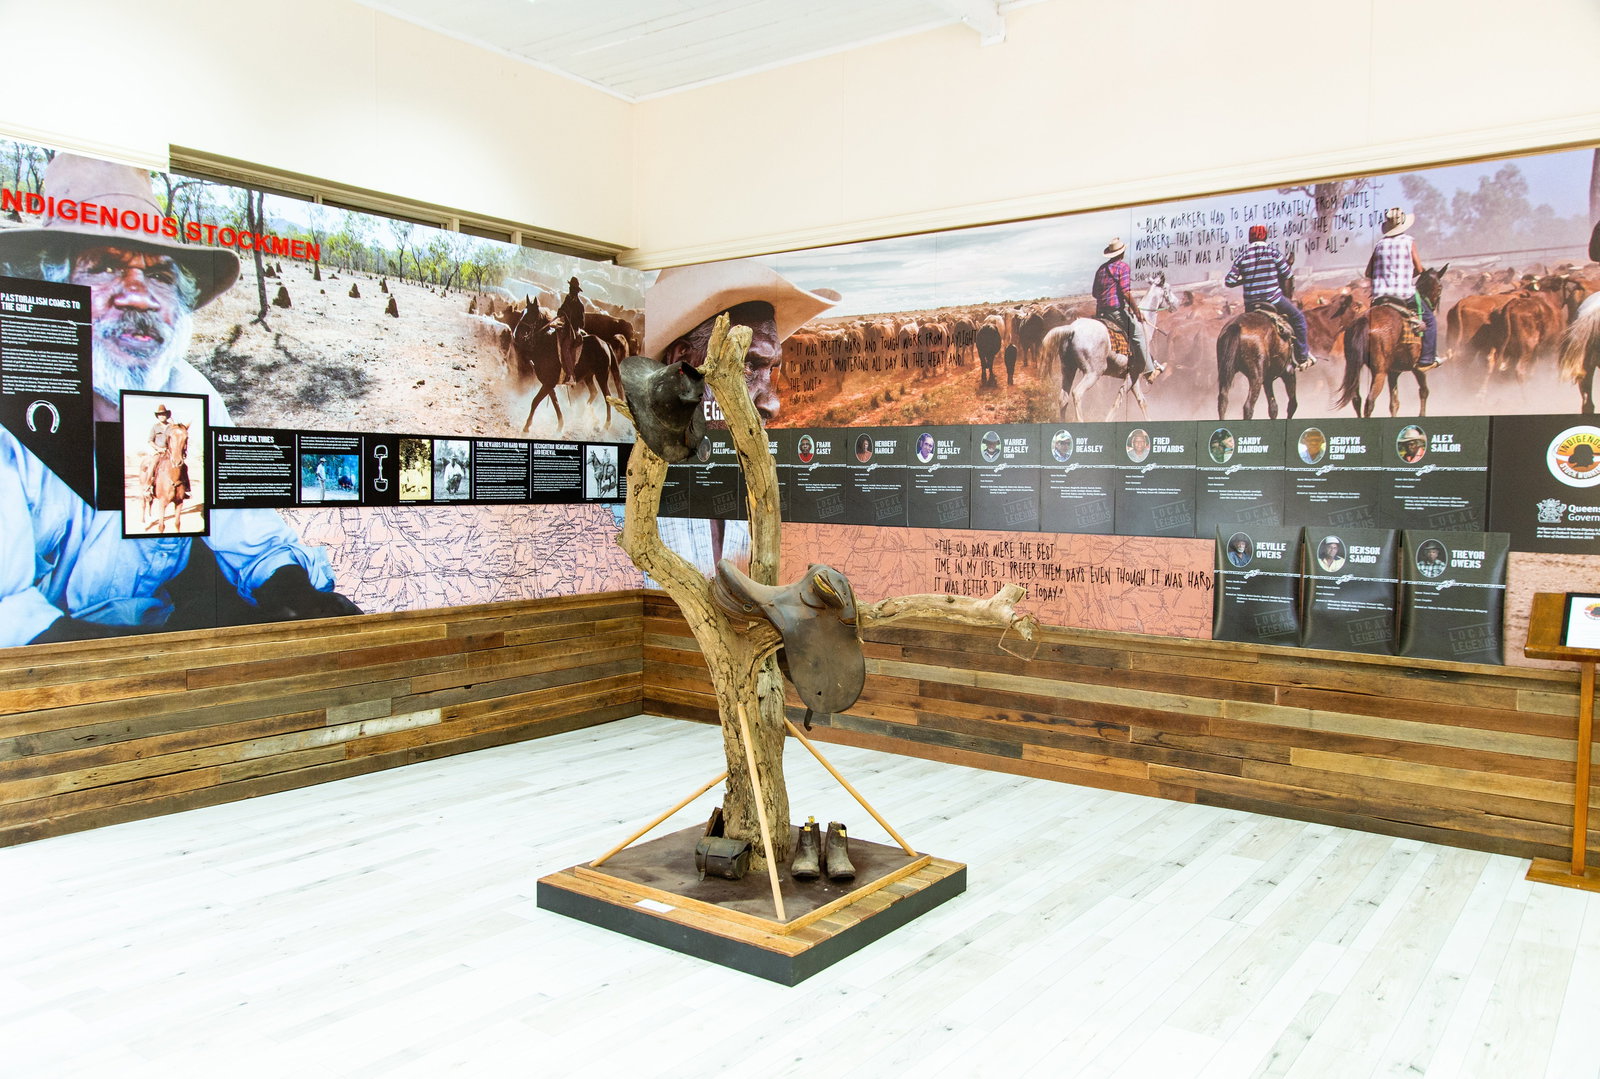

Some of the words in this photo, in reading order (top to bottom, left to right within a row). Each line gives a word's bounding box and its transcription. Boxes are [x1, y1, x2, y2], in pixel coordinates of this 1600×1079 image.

[1171, 211, 1206, 228] WORKERS
[1210, 209, 1225, 225] HAD
[1231, 207, 1239, 220] TO
[1244, 205, 1258, 222] EAT
[1263, 200, 1311, 219] SEPARATELY
[1316, 195, 1338, 211] FROM
[1342, 191, 1370, 209] WHITE
[1198, 227, 1230, 246] STARTED
[1235, 226, 1243, 239] TO
[1283, 218, 1308, 237] ABOUT
[1313, 217, 1328, 233] THE
[1334, 213, 1354, 231] TIME
[1359, 213, 1363, 228] I
[1369, 207, 1406, 228] STARTED
[185, 221, 321, 261] STOCKMEN
[1195, 249, 1212, 264] WAS
[1216, 246, 1225, 262] AT
[1230, 244, 1248, 261] SOME
[1285, 239, 1300, 256] BUT
[1305, 236, 1320, 255] NOT
[1, 293, 48, 306] PASTORALISM
[49, 298, 71, 309] COMES
[72, 301, 81, 310] TO
[1, 302, 15, 312] THE
[15, 303, 34, 313] GULF
[805, 344, 817, 356] WAS
[821, 339, 842, 355] PRETTY
[845, 338, 861, 354] HARD
[865, 339, 877, 353] AND
[881, 335, 899, 351] TOUGH
[903, 333, 922, 349] WORK
[926, 332, 943, 347] FROM
[947, 329, 977, 348] DAYLIGHT
[790, 361, 796, 372] TO
[820, 358, 831, 372] OUT
[872, 356, 881, 372] ALL
[885, 355, 897, 370] DAY
[901, 353, 908, 369] IN
[913, 352, 924, 368] THE
[928, 351, 944, 368] HEAT
[949, 353, 962, 366] AND
[790, 378, 800, 392] THE
[223, 434, 240, 443] CLASH
[241, 435, 247, 443] OF
[248, 435, 275, 443] CULTURES
[1003, 438, 1027, 446] WARREN
[1076, 437, 1088, 445] ROY
[1152, 436, 1170, 445] FRED
[1238, 436, 1262, 445] SANDY
[1329, 436, 1361, 445] MERVYN
[1430, 434, 1454, 443] ALEX
[937, 447, 961, 455] BEASLEY
[1076, 445, 1104, 453] BEASLEY
[1152, 444, 1185, 453] EDWARDS
[1238, 445, 1269, 454] RAINBOW
[1329, 445, 1367, 454] EDWARDS
[1430, 443, 1462, 453] SAILOR
[956, 541, 967, 558] OLD
[972, 541, 989, 557] DAYS
[993, 541, 1014, 558] WERE
[1019, 541, 1033, 560] THE
[1037, 543, 1054, 560] BEST
[1256, 542, 1287, 551] NEVILLE
[1349, 545, 1381, 555] BENSON
[1256, 551, 1282, 559] OWENS
[1349, 555, 1377, 564] SAMBO
[1451, 550, 1485, 560] TREVOR
[1451, 560, 1482, 569] OWENS
[935, 557, 950, 575] TIME
[955, 559, 963, 576] IN
[967, 559, 977, 577] MY
[1002, 562, 1006, 577] I
[1009, 561, 1038, 580] PREFER
[1042, 563, 1062, 581] THEM
[1066, 567, 1085, 583] DAYS
[1090, 565, 1111, 586] EVEN
[1116, 566, 1147, 587] THOUGH
[1152, 568, 1160, 586] IT
[1164, 572, 1183, 589] WAS
[934, 576, 941, 592] IT
[944, 580, 959, 595] WAS
[963, 579, 989, 597] BETTER
